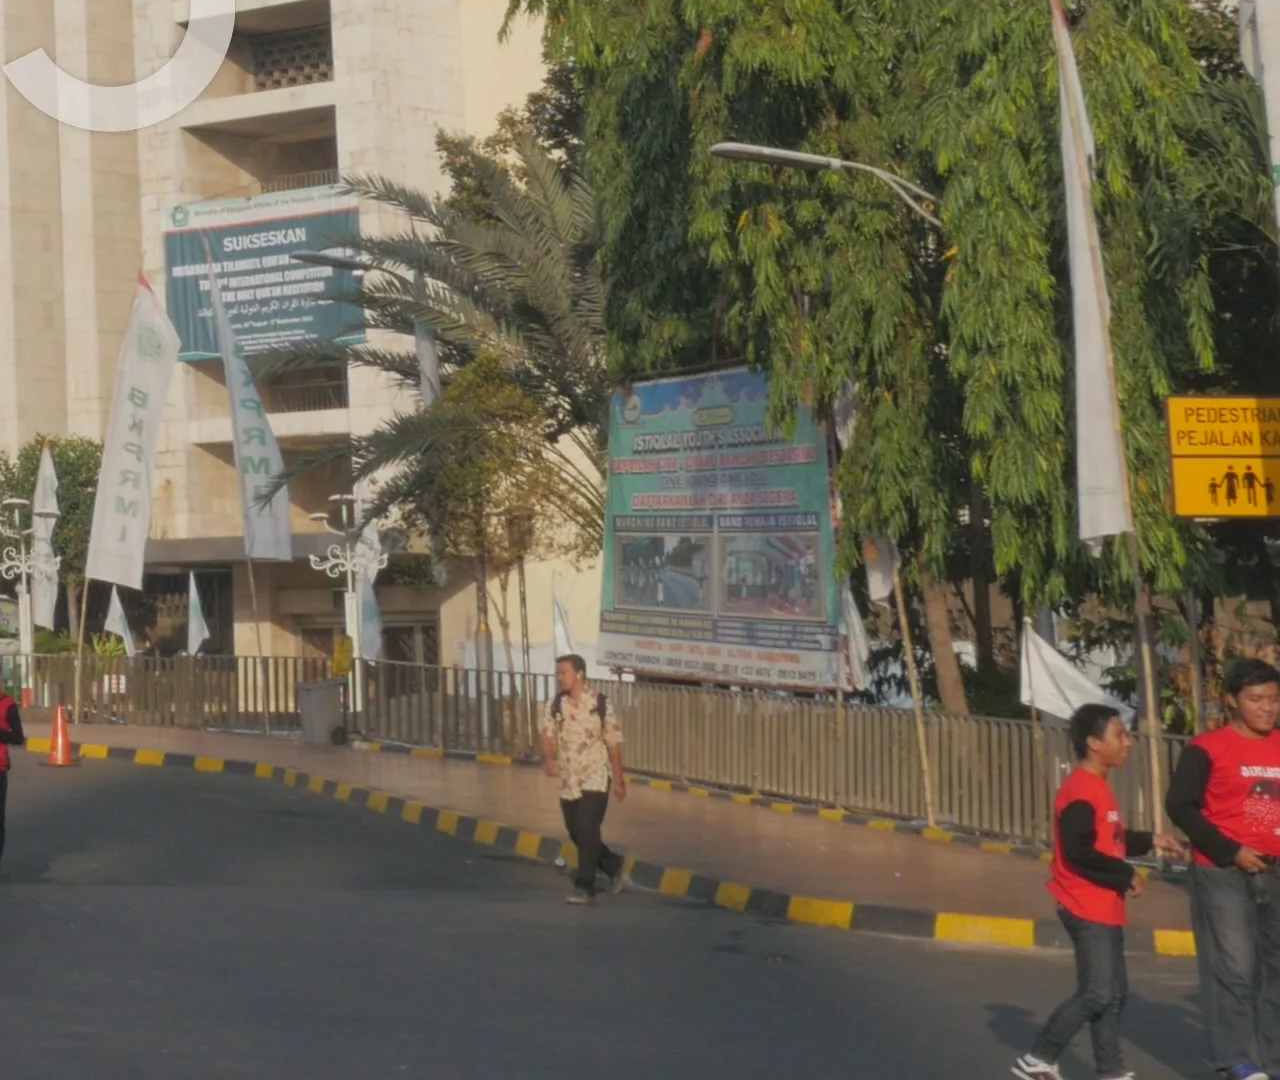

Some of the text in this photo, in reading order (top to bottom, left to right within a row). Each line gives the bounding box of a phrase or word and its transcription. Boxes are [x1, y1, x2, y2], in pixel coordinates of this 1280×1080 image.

[223, 227, 306, 252] SUKSESKAN
[1184, 407, 1280, 423] PEDESTRIA
[1176, 430, 1254, 446] PEJALAN
